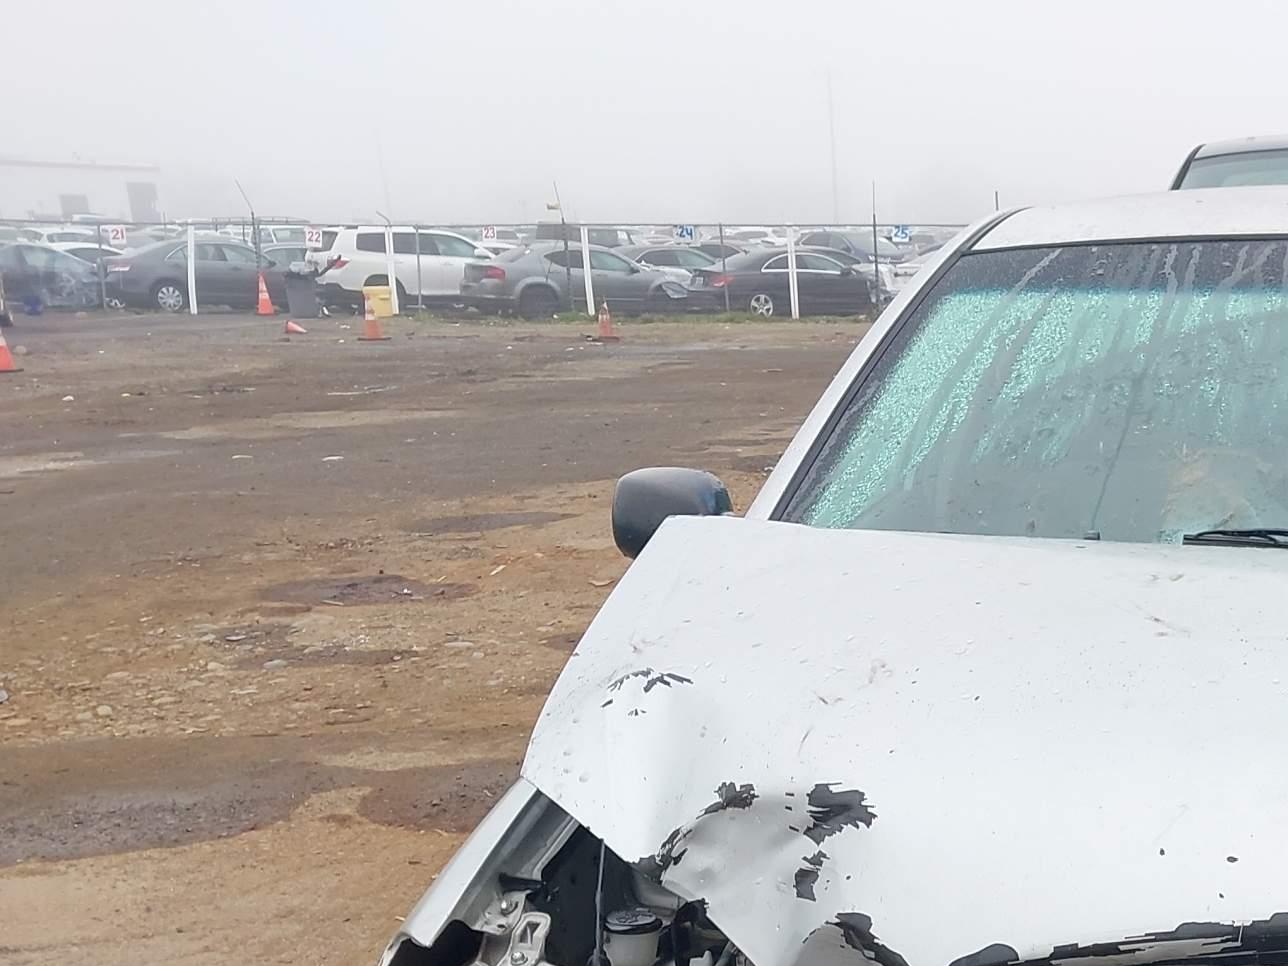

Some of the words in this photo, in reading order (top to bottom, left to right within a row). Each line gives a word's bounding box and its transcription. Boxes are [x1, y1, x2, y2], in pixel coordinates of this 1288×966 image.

[111, 228, 124, 240] 21
[307, 231, 321, 242] 22
[484, 226, 495, 239] 23
[679, 225, 693, 240] 24
[895, 225, 908, 239] 25
